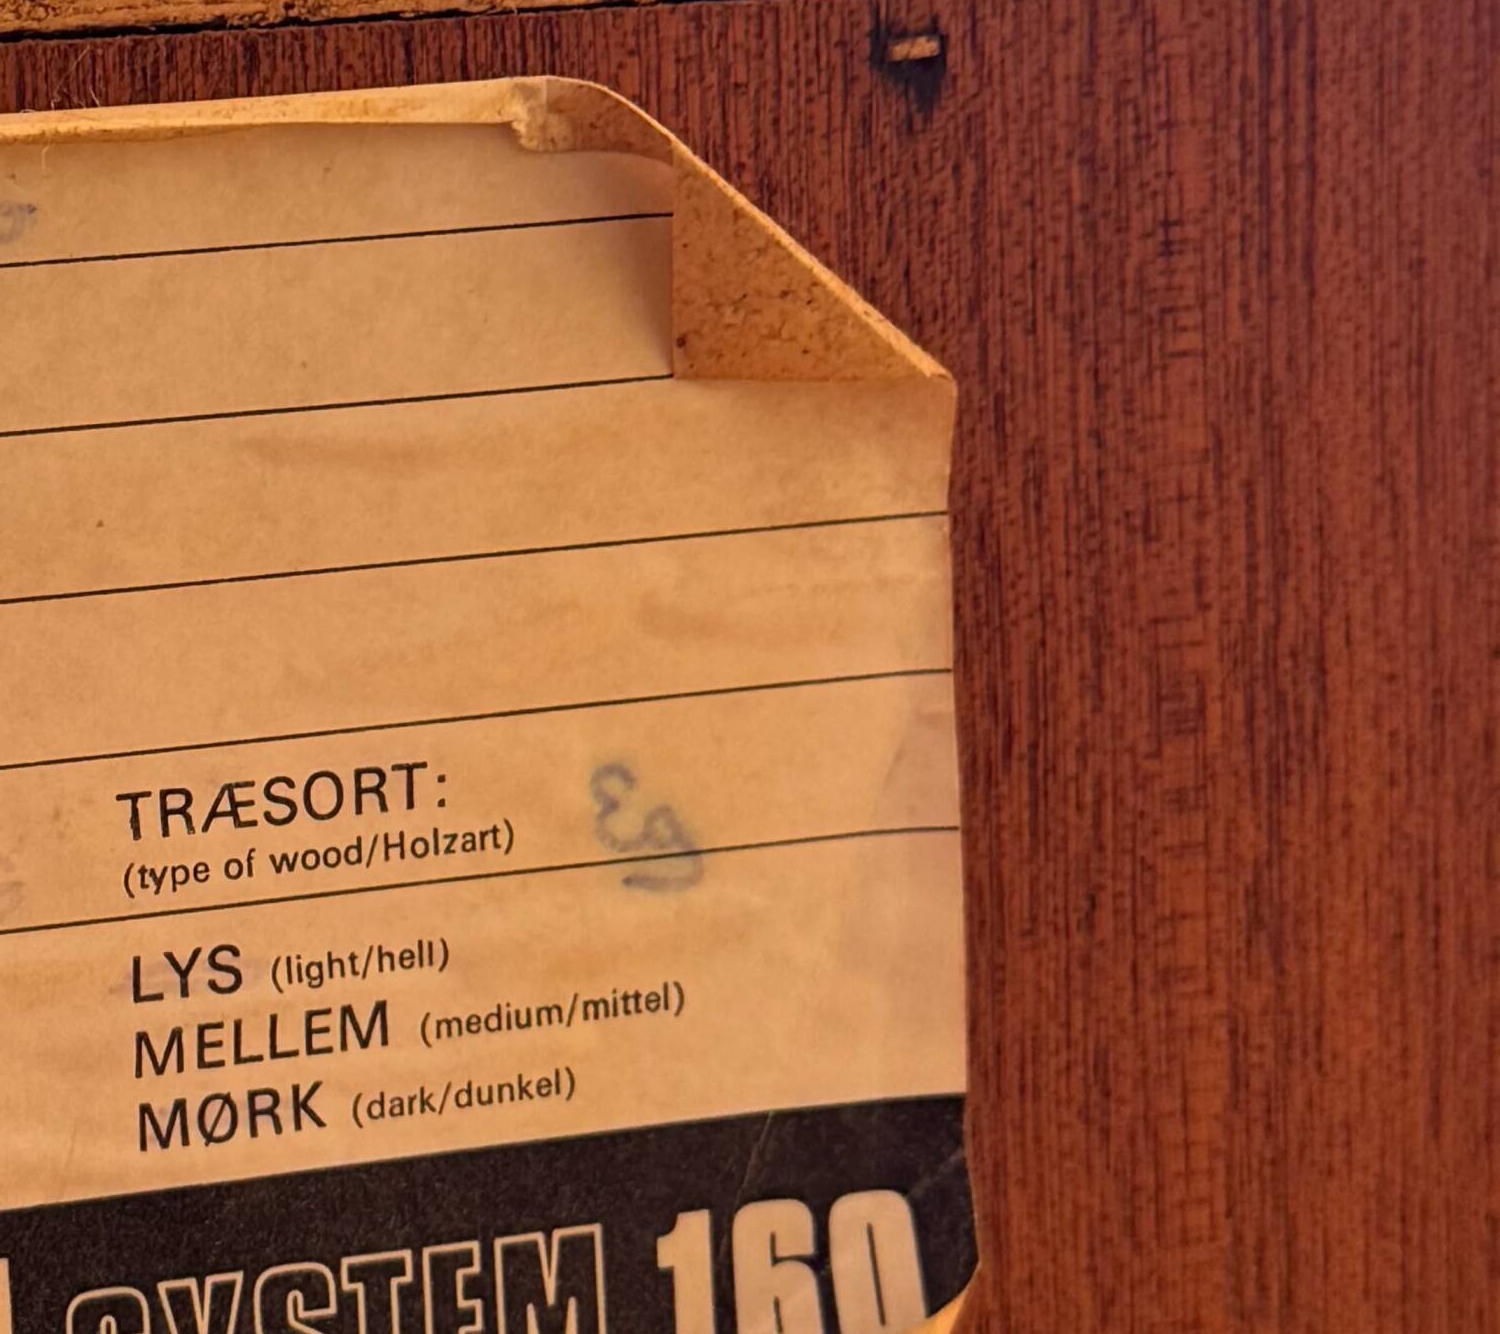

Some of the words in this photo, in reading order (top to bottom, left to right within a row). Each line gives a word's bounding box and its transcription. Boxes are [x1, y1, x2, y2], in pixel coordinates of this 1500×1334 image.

[116, 762, 446, 841] TRÆSORT:
[124, 862, 209, 898] (type
[224, 848, 255, 880] of
[269, 819, 513, 874] wood/Holzart)
[132, 945, 242, 1003] LYS
[272, 938, 449, 993] (light/hell)
[135, 1000, 388, 1078] MELLEM
[421, 982, 684, 1047] (medium/mittel)
[139, 1082, 326, 1151] MØRK
[353, 1067, 575, 1127] (dark/dunkel)
